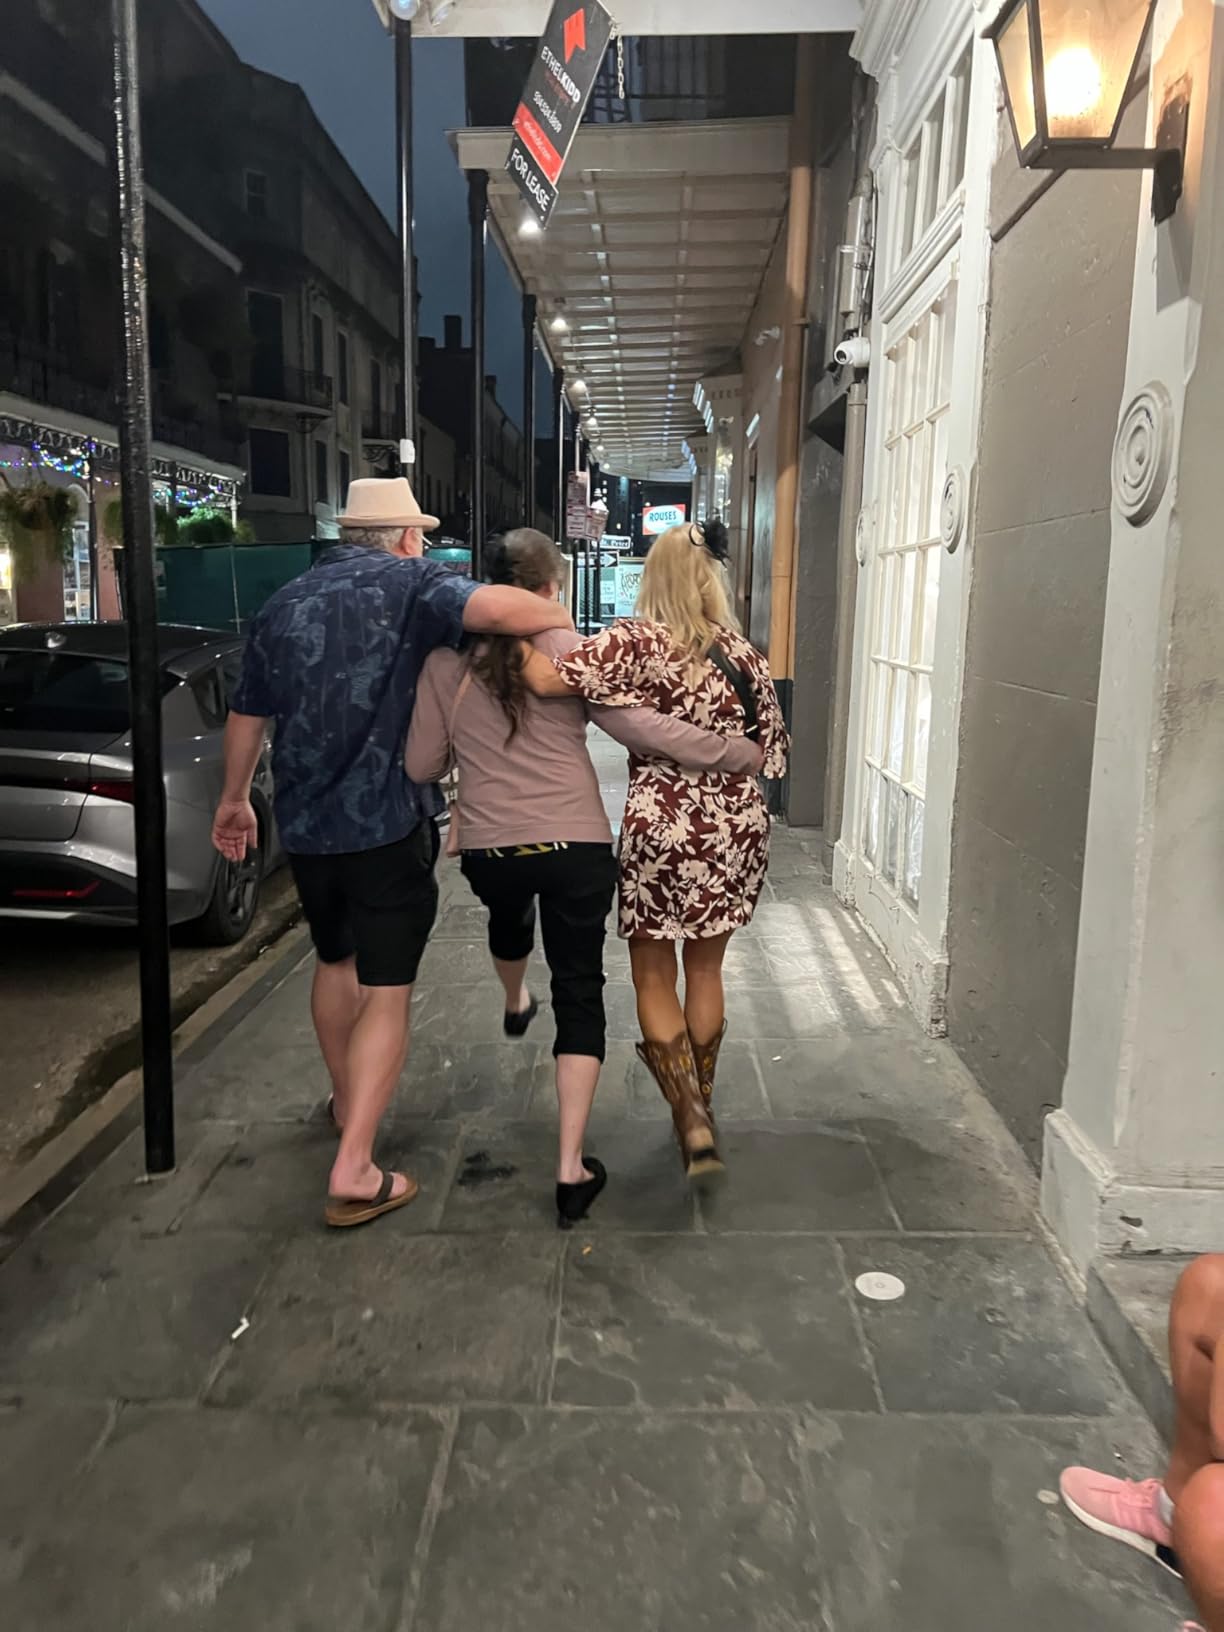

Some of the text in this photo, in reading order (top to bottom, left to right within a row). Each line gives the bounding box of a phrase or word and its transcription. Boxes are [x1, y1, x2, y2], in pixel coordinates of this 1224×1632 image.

[511, 148, 528, 179] FOR
[526, 170, 550, 212] LEASE
[649, 511, 677, 522] ROUSES
